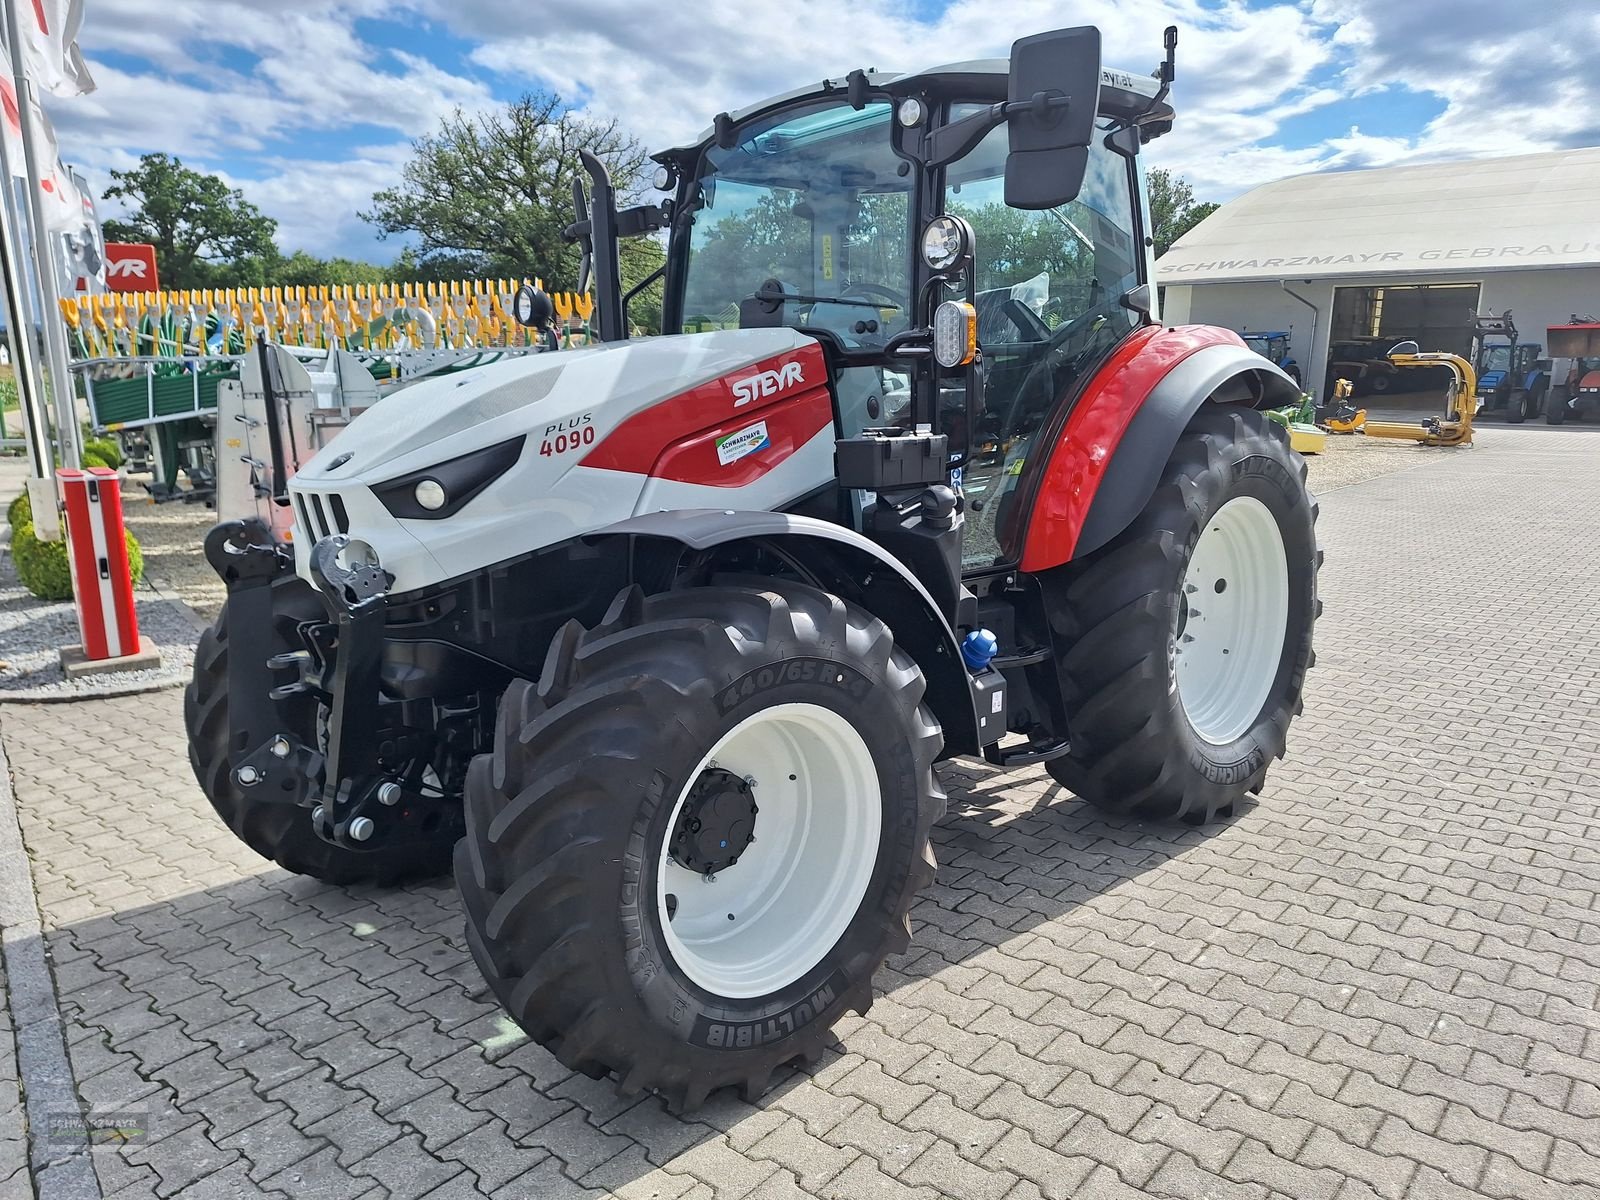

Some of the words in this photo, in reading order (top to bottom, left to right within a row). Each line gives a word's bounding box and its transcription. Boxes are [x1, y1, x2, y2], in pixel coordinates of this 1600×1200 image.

[1101, 71, 1132, 87] ayr.at
[1158, 252, 1404, 274] SCHWARZMAYR
[732, 361, 805, 408] STEYR
[545, 412, 592, 437] PLUS
[721, 429, 760, 450] SCHWARZMAYR
[540, 426, 595, 457] 4090
[722, 660, 817, 708] 440/65
[1190, 750, 1250, 785] MICHELIN
[706, 983, 836, 1049] MULTIBIB
